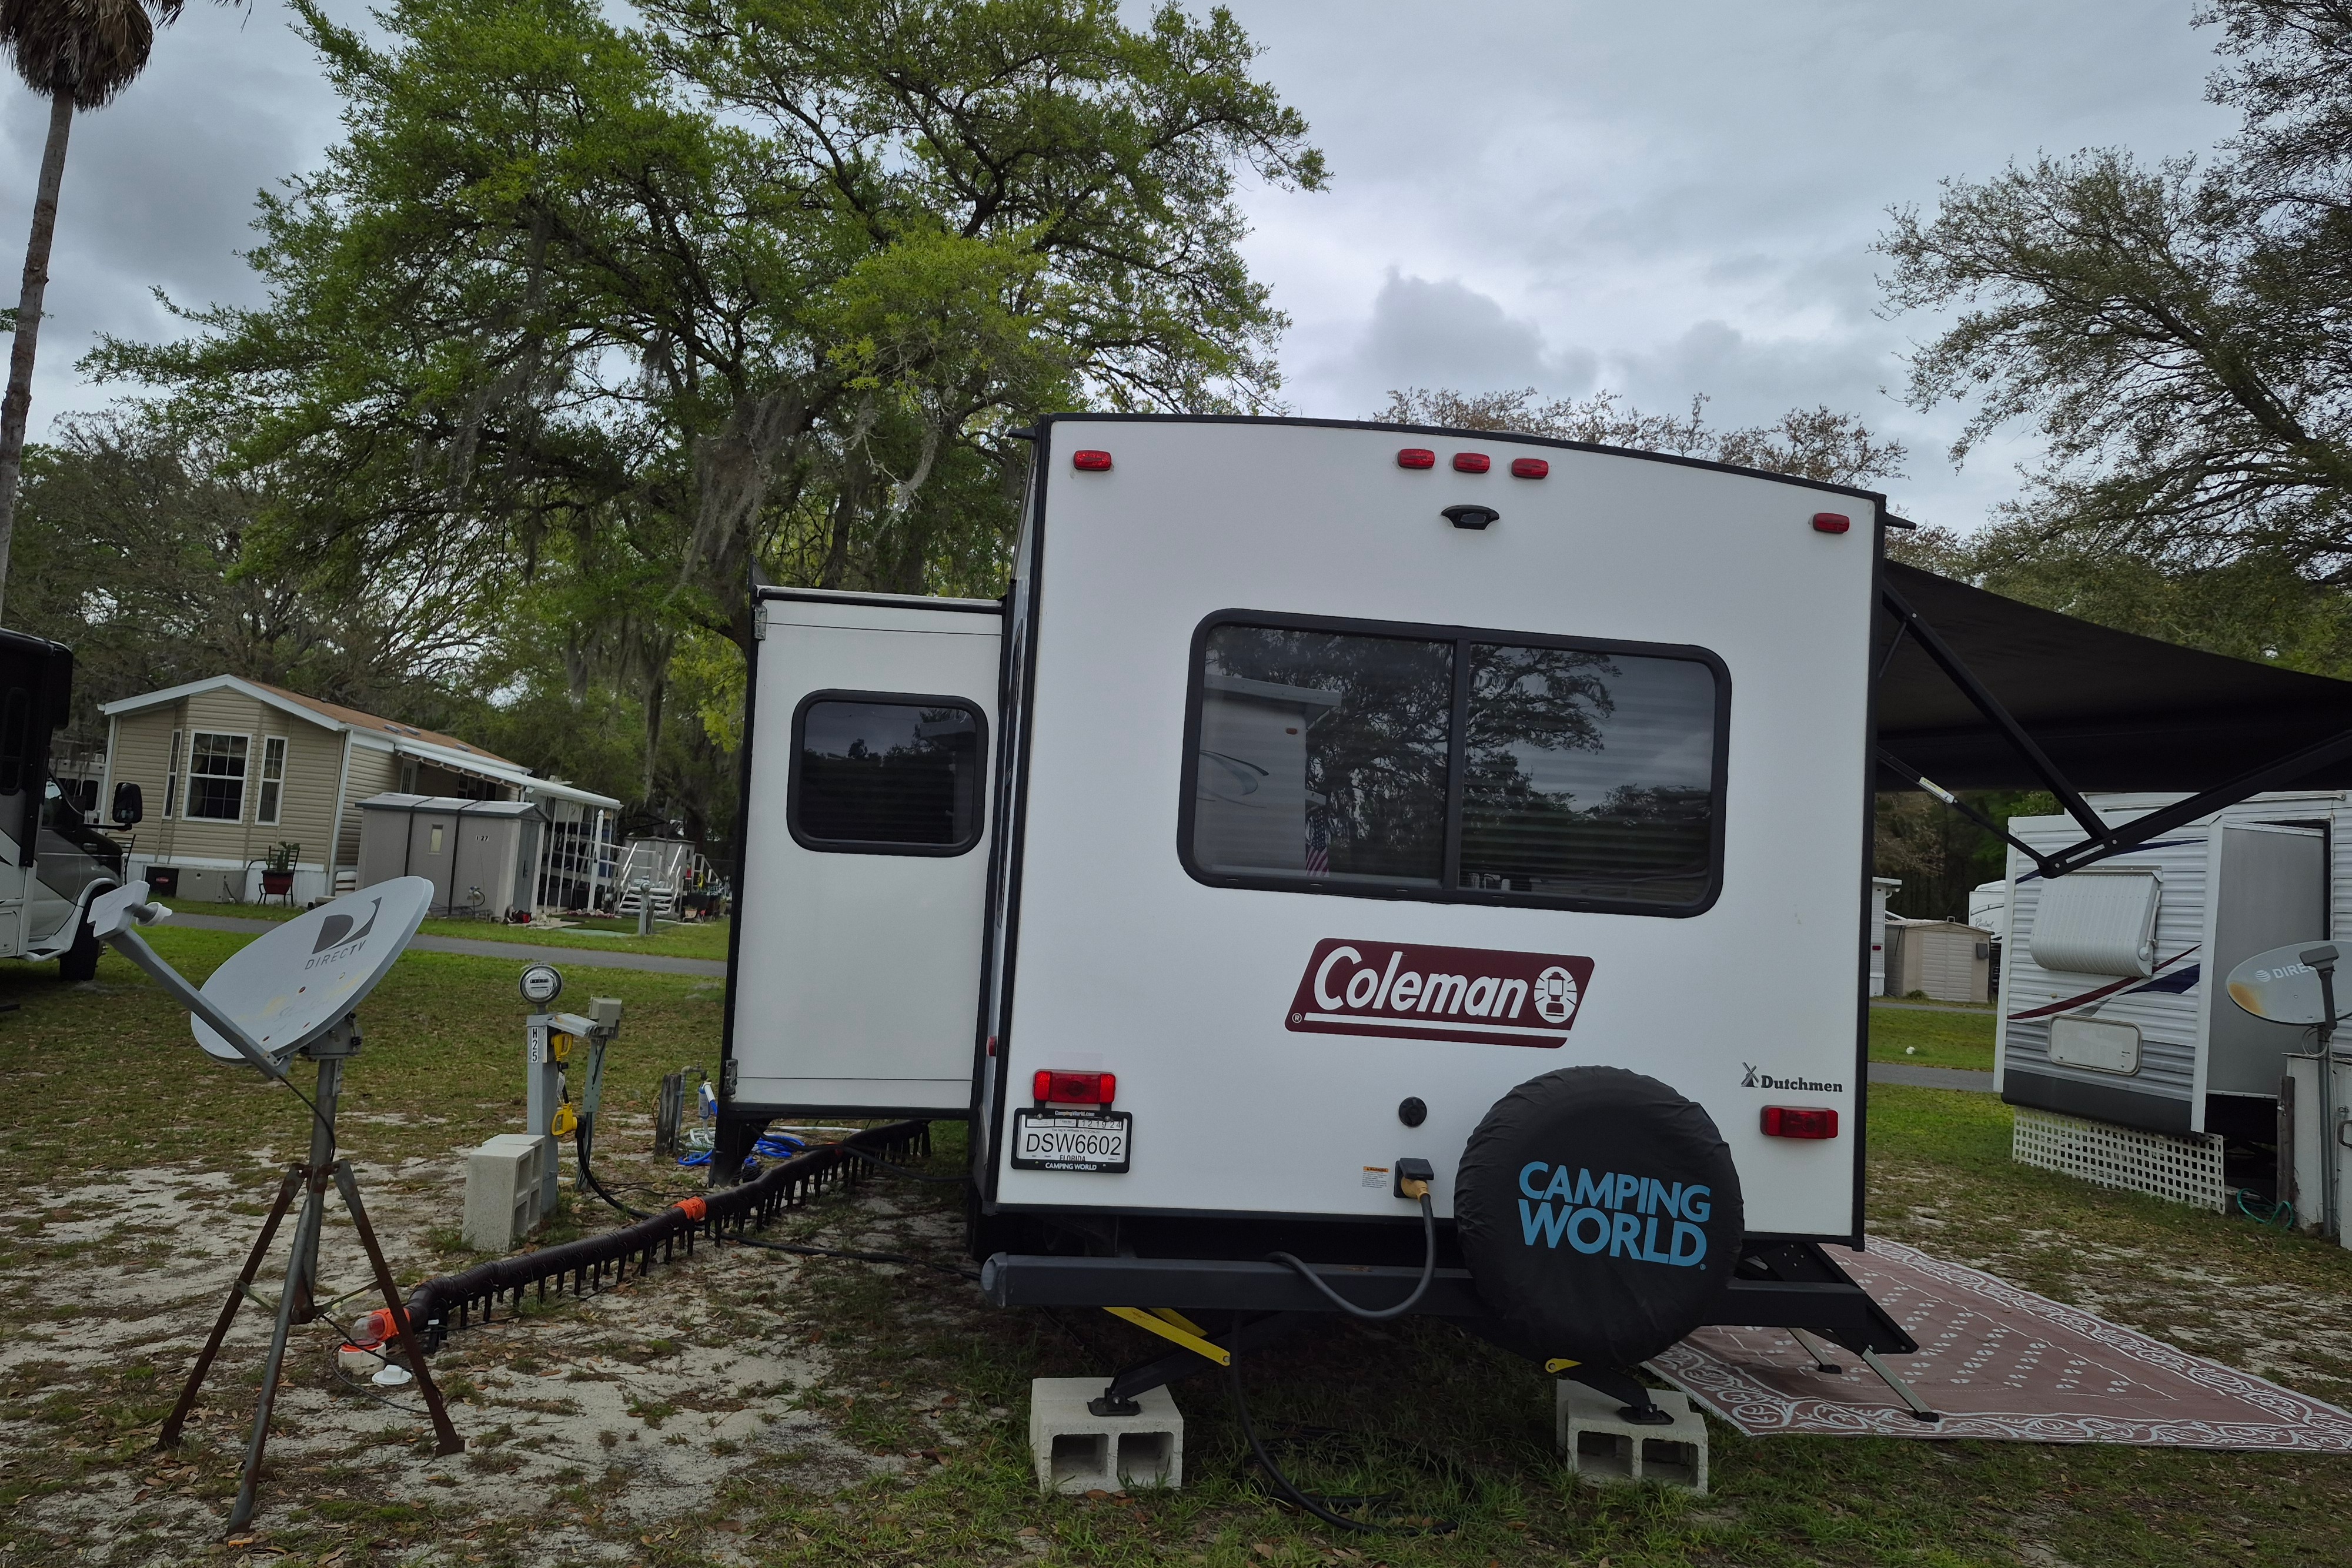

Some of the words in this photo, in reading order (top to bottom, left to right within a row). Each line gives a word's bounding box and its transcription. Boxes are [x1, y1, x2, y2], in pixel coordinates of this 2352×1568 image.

[305, 940, 366, 969] DIRECTV
[1314, 946, 1528, 1019] Coleman
[1761, 1075, 1843, 1092] Dutchmen
[1026, 1133, 1121, 1155] DSW6602
[1045, 1162, 1074, 1170] CAMPING
[1519, 1161, 1710, 1222] CAMPING
[1518, 1199, 1707, 1267] WORLD
